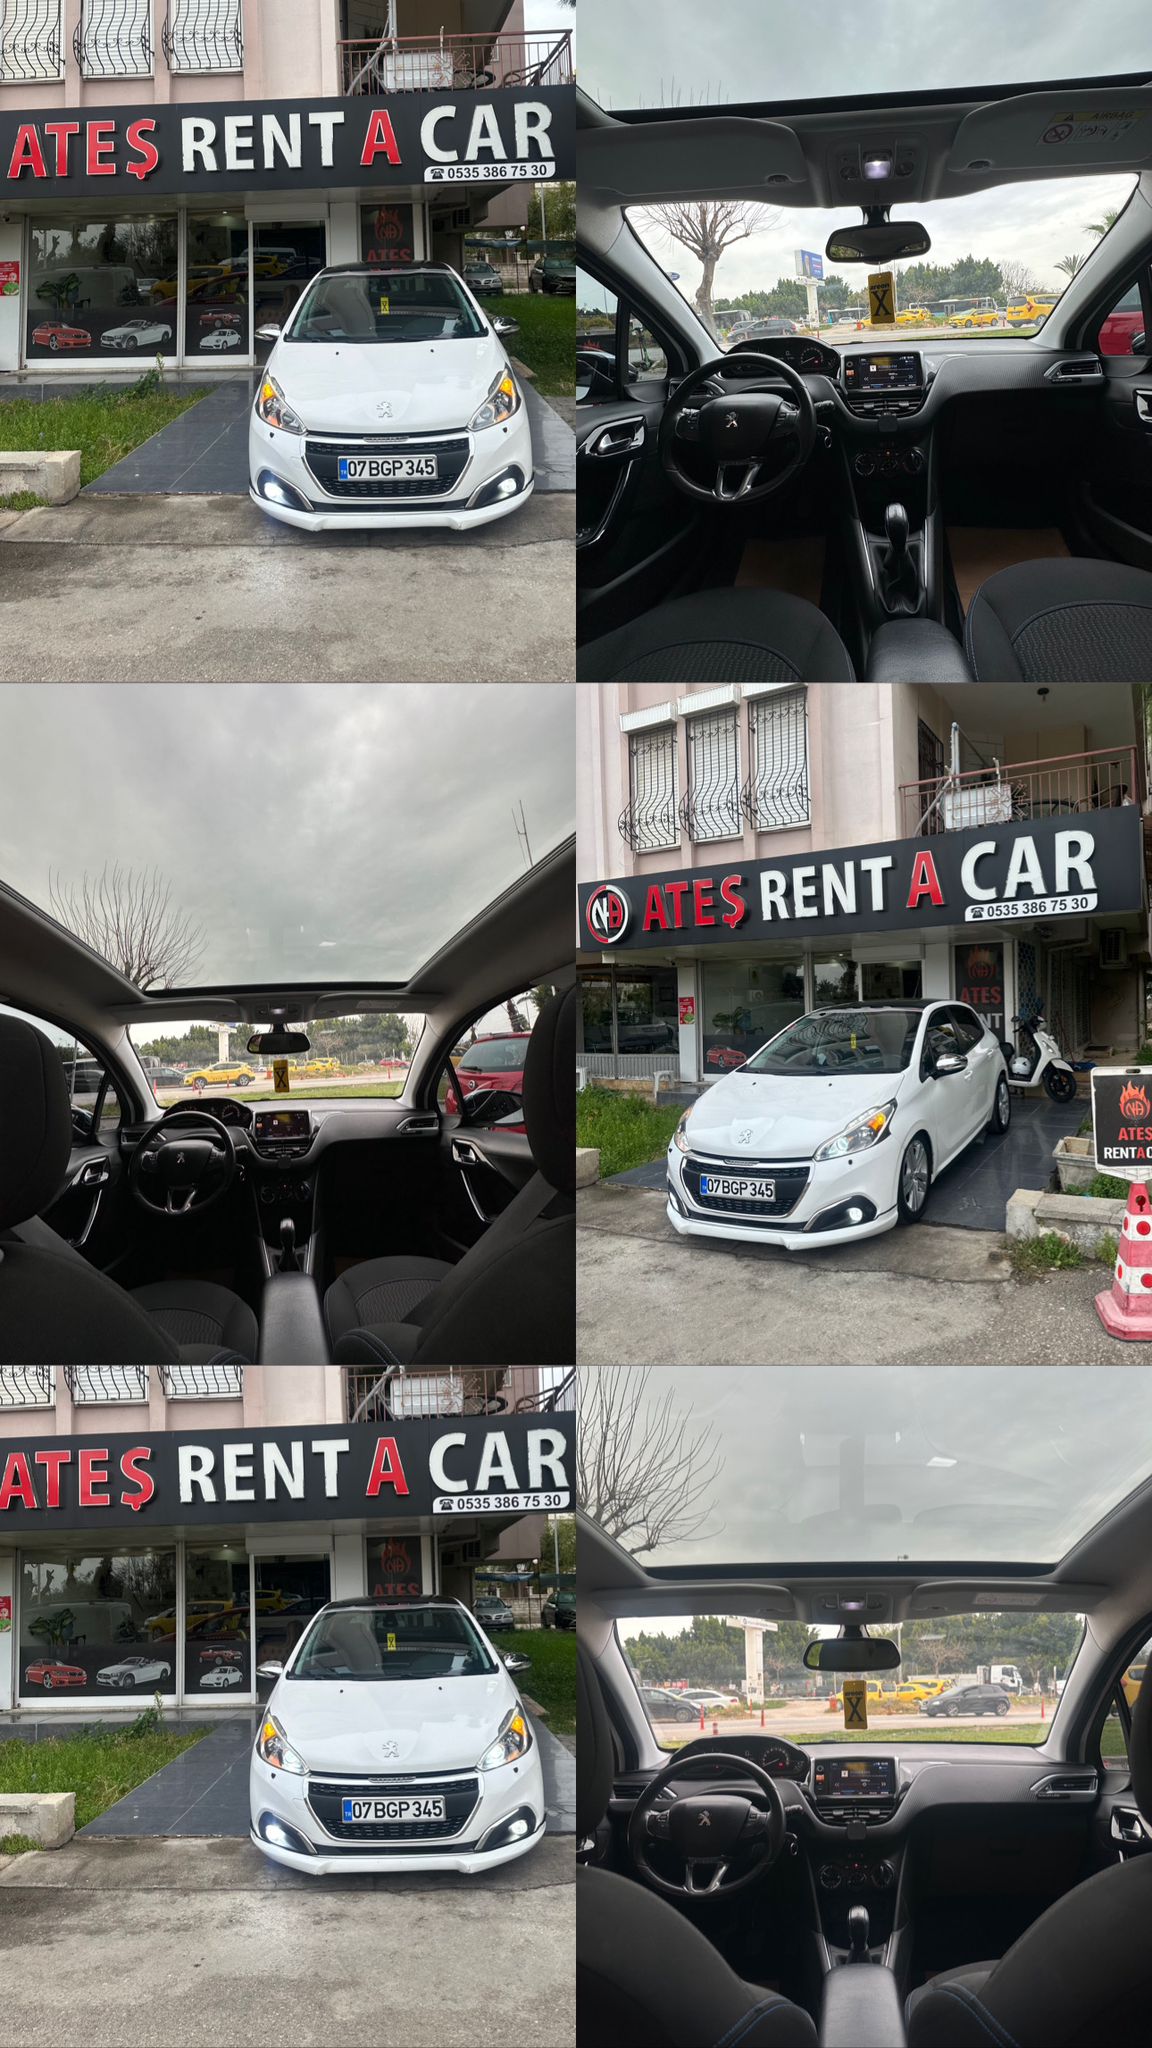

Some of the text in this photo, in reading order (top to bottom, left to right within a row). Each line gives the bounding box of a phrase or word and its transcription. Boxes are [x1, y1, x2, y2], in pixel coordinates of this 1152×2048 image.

[7, 101, 555, 180] ATEŞ RENT A CAR
[447, 164, 547, 179] 0535 386 75 30
[871, 290, 892, 316] X
[642, 874, 745, 928] ATEŞ
[760, 855, 893, 921] RENT
[906, 850, 944, 908] A
[961, 830, 1097, 900] CAR
[987, 897, 1089, 917] 0535 386 75 30
[276, 1070, 287, 1088] X
[0, 1428, 569, 1511] ATEŞ RENT A CAR
[457, 1494, 561, 1510] 0535 386 75 30
[846, 1697, 865, 1722] X
